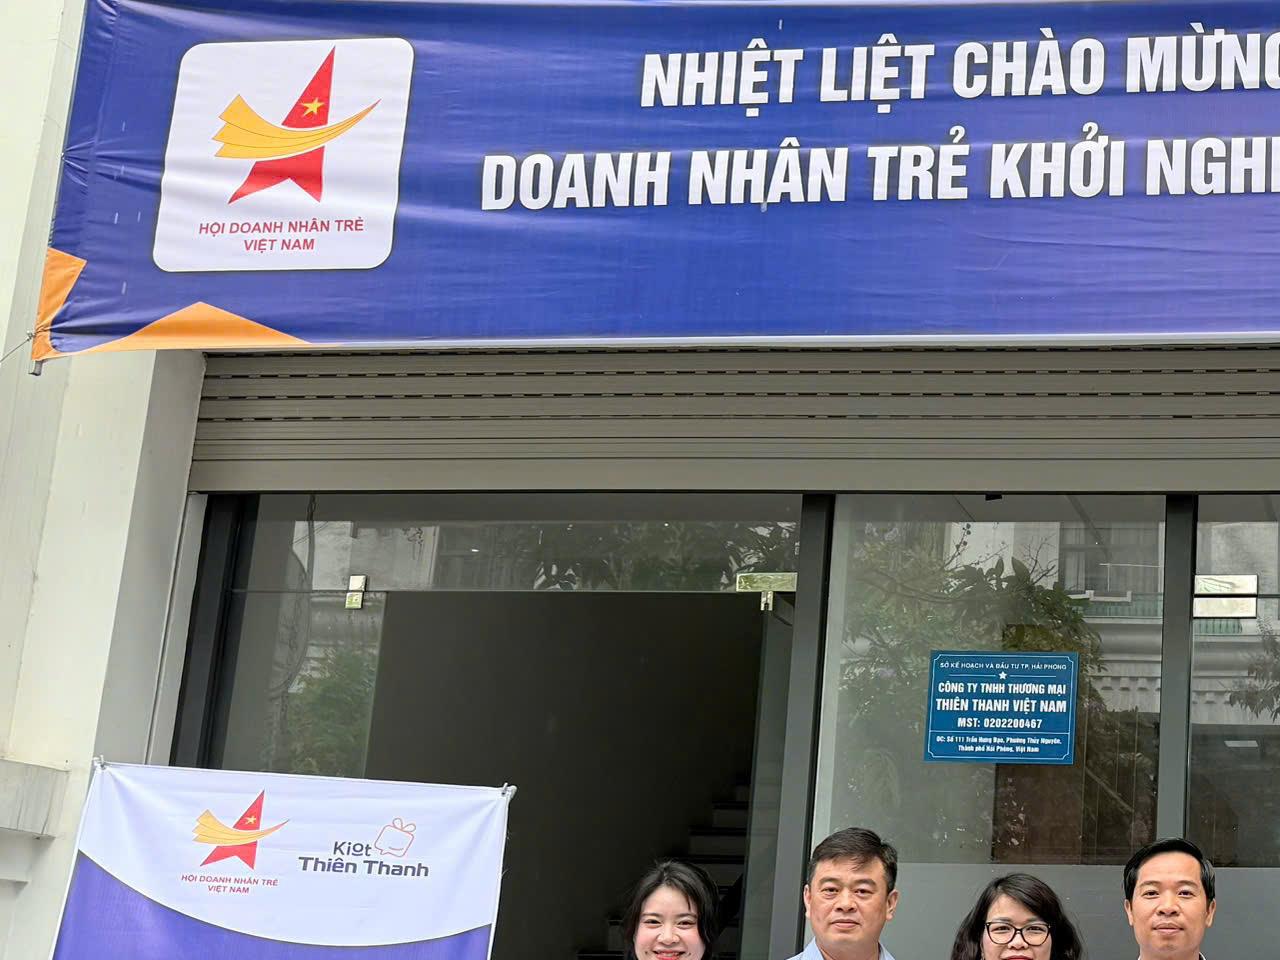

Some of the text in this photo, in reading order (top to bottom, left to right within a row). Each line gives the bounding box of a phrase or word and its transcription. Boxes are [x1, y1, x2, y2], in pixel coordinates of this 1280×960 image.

[640, 37, 804, 117] NHIỆT
[820, 33, 935, 114] LIỆT
[952, 27, 1105, 98] CHÀO
[481, 151, 671, 211] DOANH
[688, 136, 848, 207] NHÂN
[867, 125, 971, 202] TRẺ
[989, 121, 1125, 199] KHỞI
[198, 216, 365, 237] HỘI DOANH NHÂN TRẺ
[243, 238, 315, 253] VIỆT NAM
[938, 681, 1066, 697] CÔNG TY TNHH THƯƠNG MẠI
[935, 696, 1066, 714] THIÊN THANH VIỆT NAM
[957, 717, 1043, 729] MST: 0202200467
[333, 841, 372, 857] Kiot
[298, 856, 429, 877] Thiên Thanh
[199, 874, 232, 884] DOANH
[233, 874, 260, 885] NHÂN
[207, 884, 250, 895] VIỆT NAM
